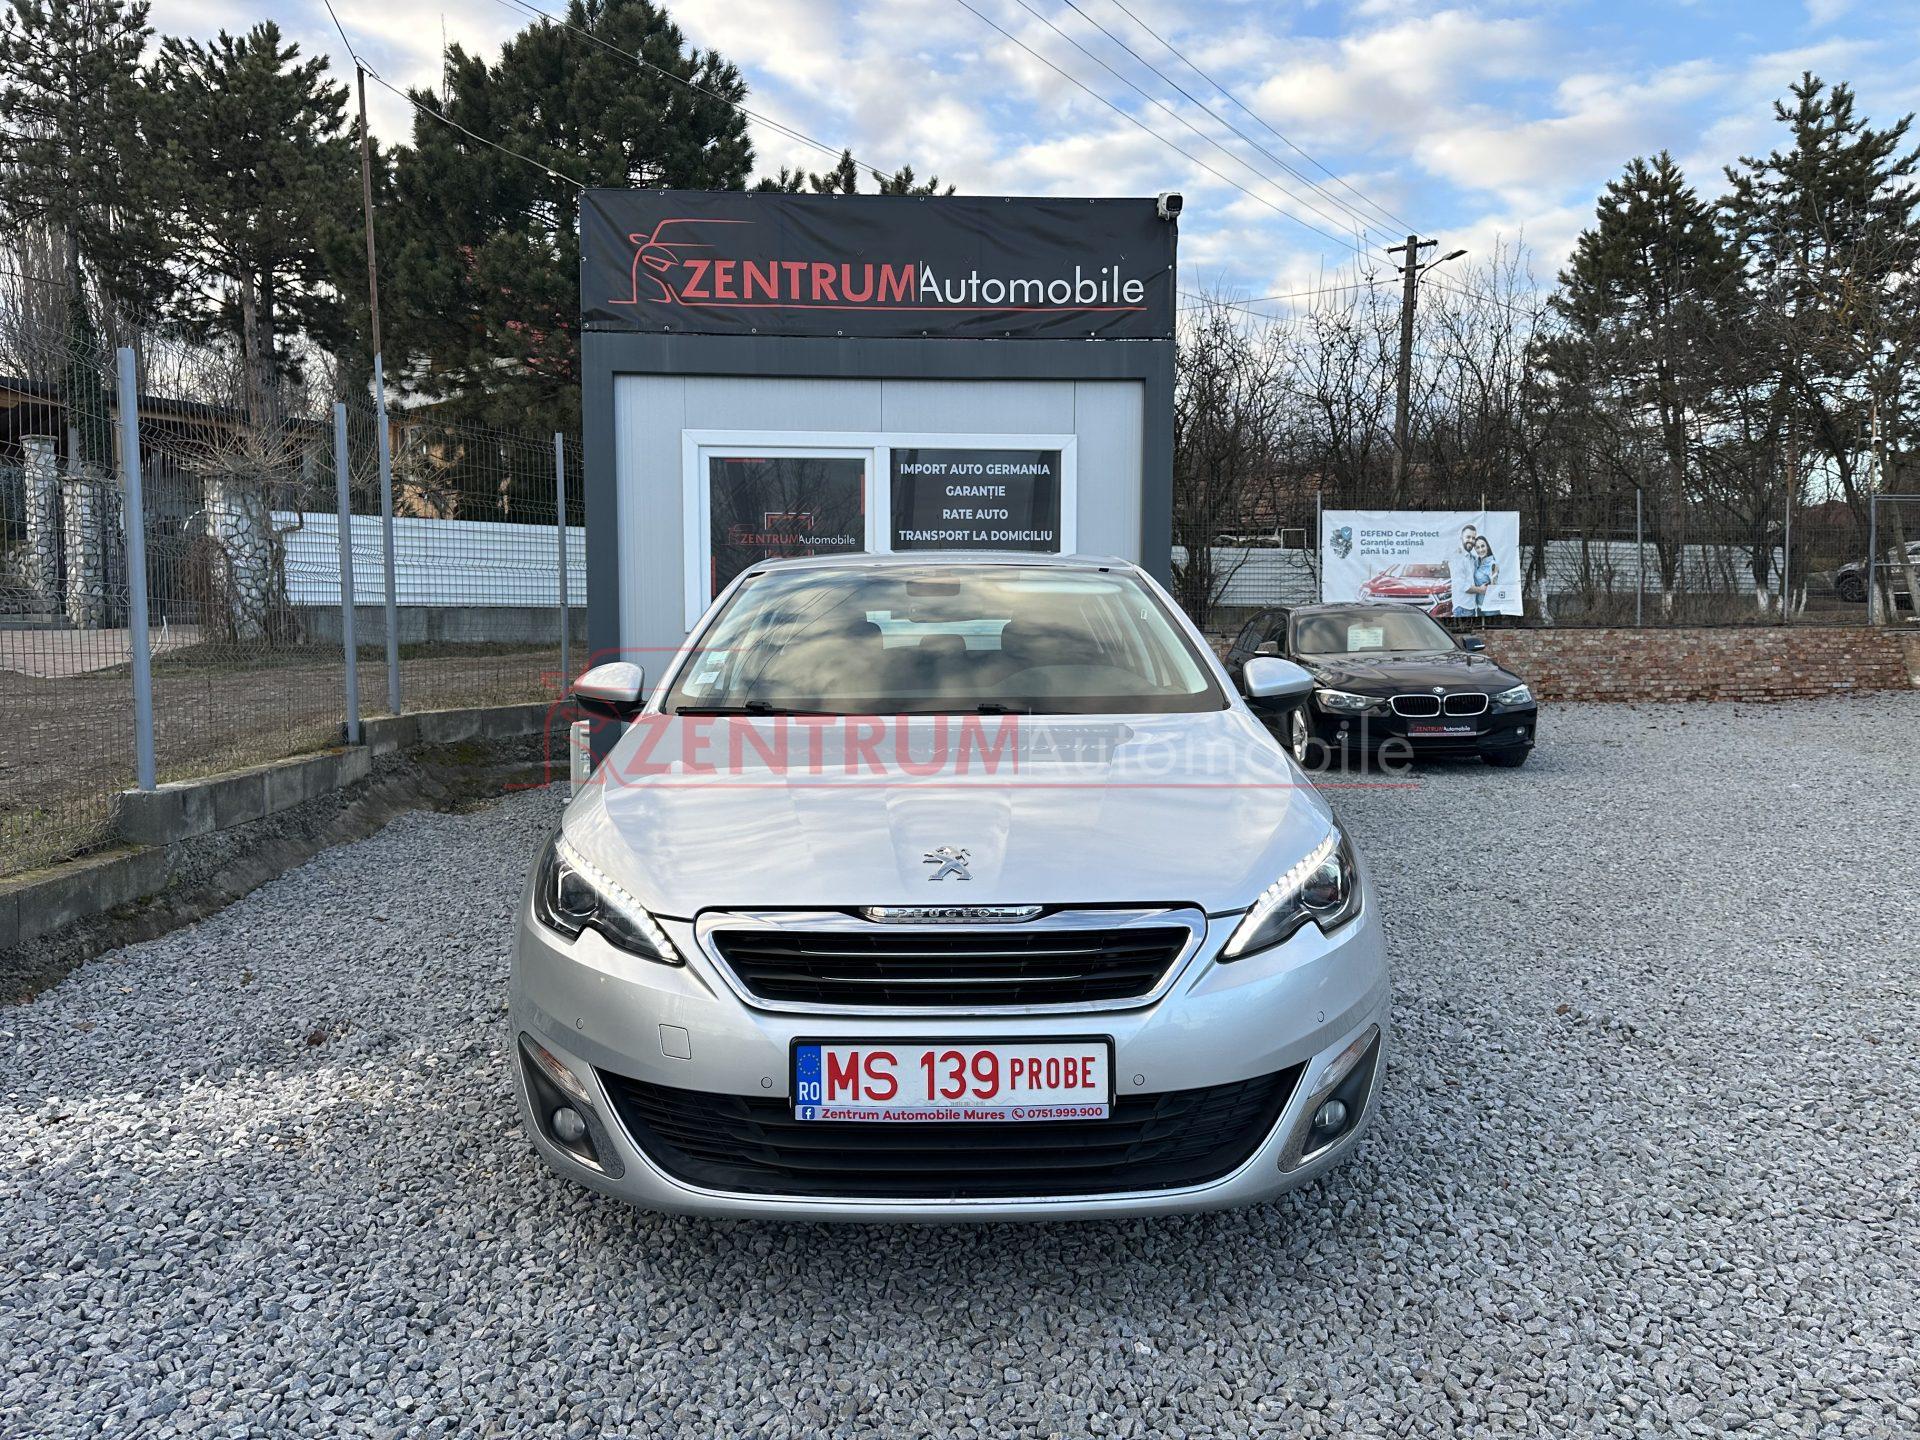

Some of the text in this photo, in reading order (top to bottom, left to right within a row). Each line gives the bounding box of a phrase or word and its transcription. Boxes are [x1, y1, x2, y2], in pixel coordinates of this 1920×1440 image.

[682, 259, 1145, 304] ZENTRUM Automobile
[900, 463, 1050, 476] IMPORT AUTO GERMANIA
[946, 485, 1006, 499] GARANȚIE
[942, 509, 1009, 521] RATE AUTO
[740, 533, 856, 545] ZENTRUM Automobile
[899, 530, 1053, 542] TRANSPORT LA DOMICILIU
[1395, 530, 1408, 538] Car
[1410, 530, 1439, 538] Protect
[1397, 547, 1410, 555] ani
[827, 1051, 1096, 1100] MS 139 PROBE
[799, 1082, 820, 1100] RO
[822, 1107, 1103, 1121] Zentrum Automobile Mures 0751.999.900
